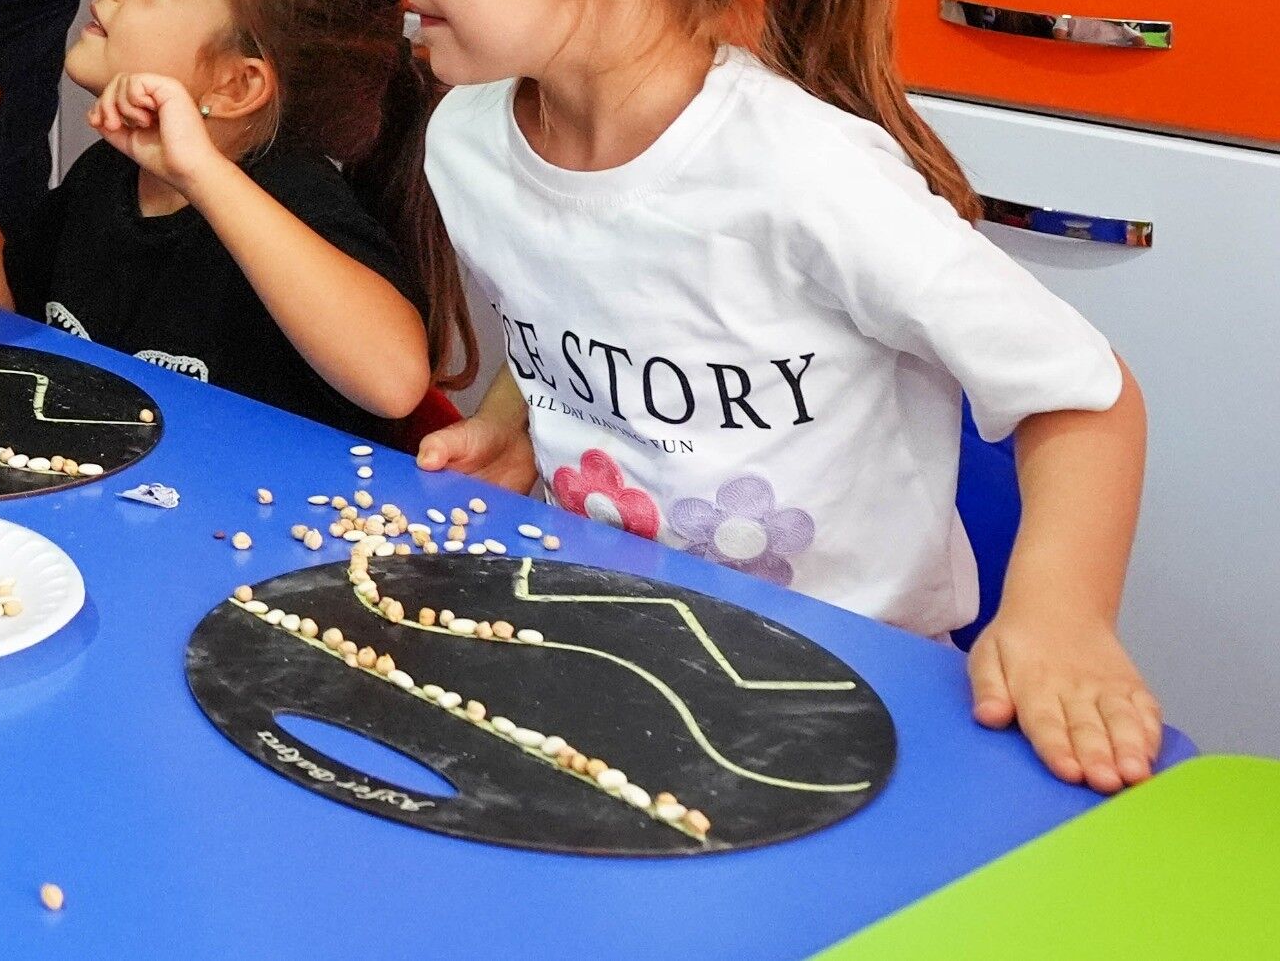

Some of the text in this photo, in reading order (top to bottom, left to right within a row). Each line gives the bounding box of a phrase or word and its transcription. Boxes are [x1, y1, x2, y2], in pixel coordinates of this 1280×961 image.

[527, 394, 557, 412] ALL
[562, 402, 585, 420] DAY
[561, 329, 816, 430] STORY
